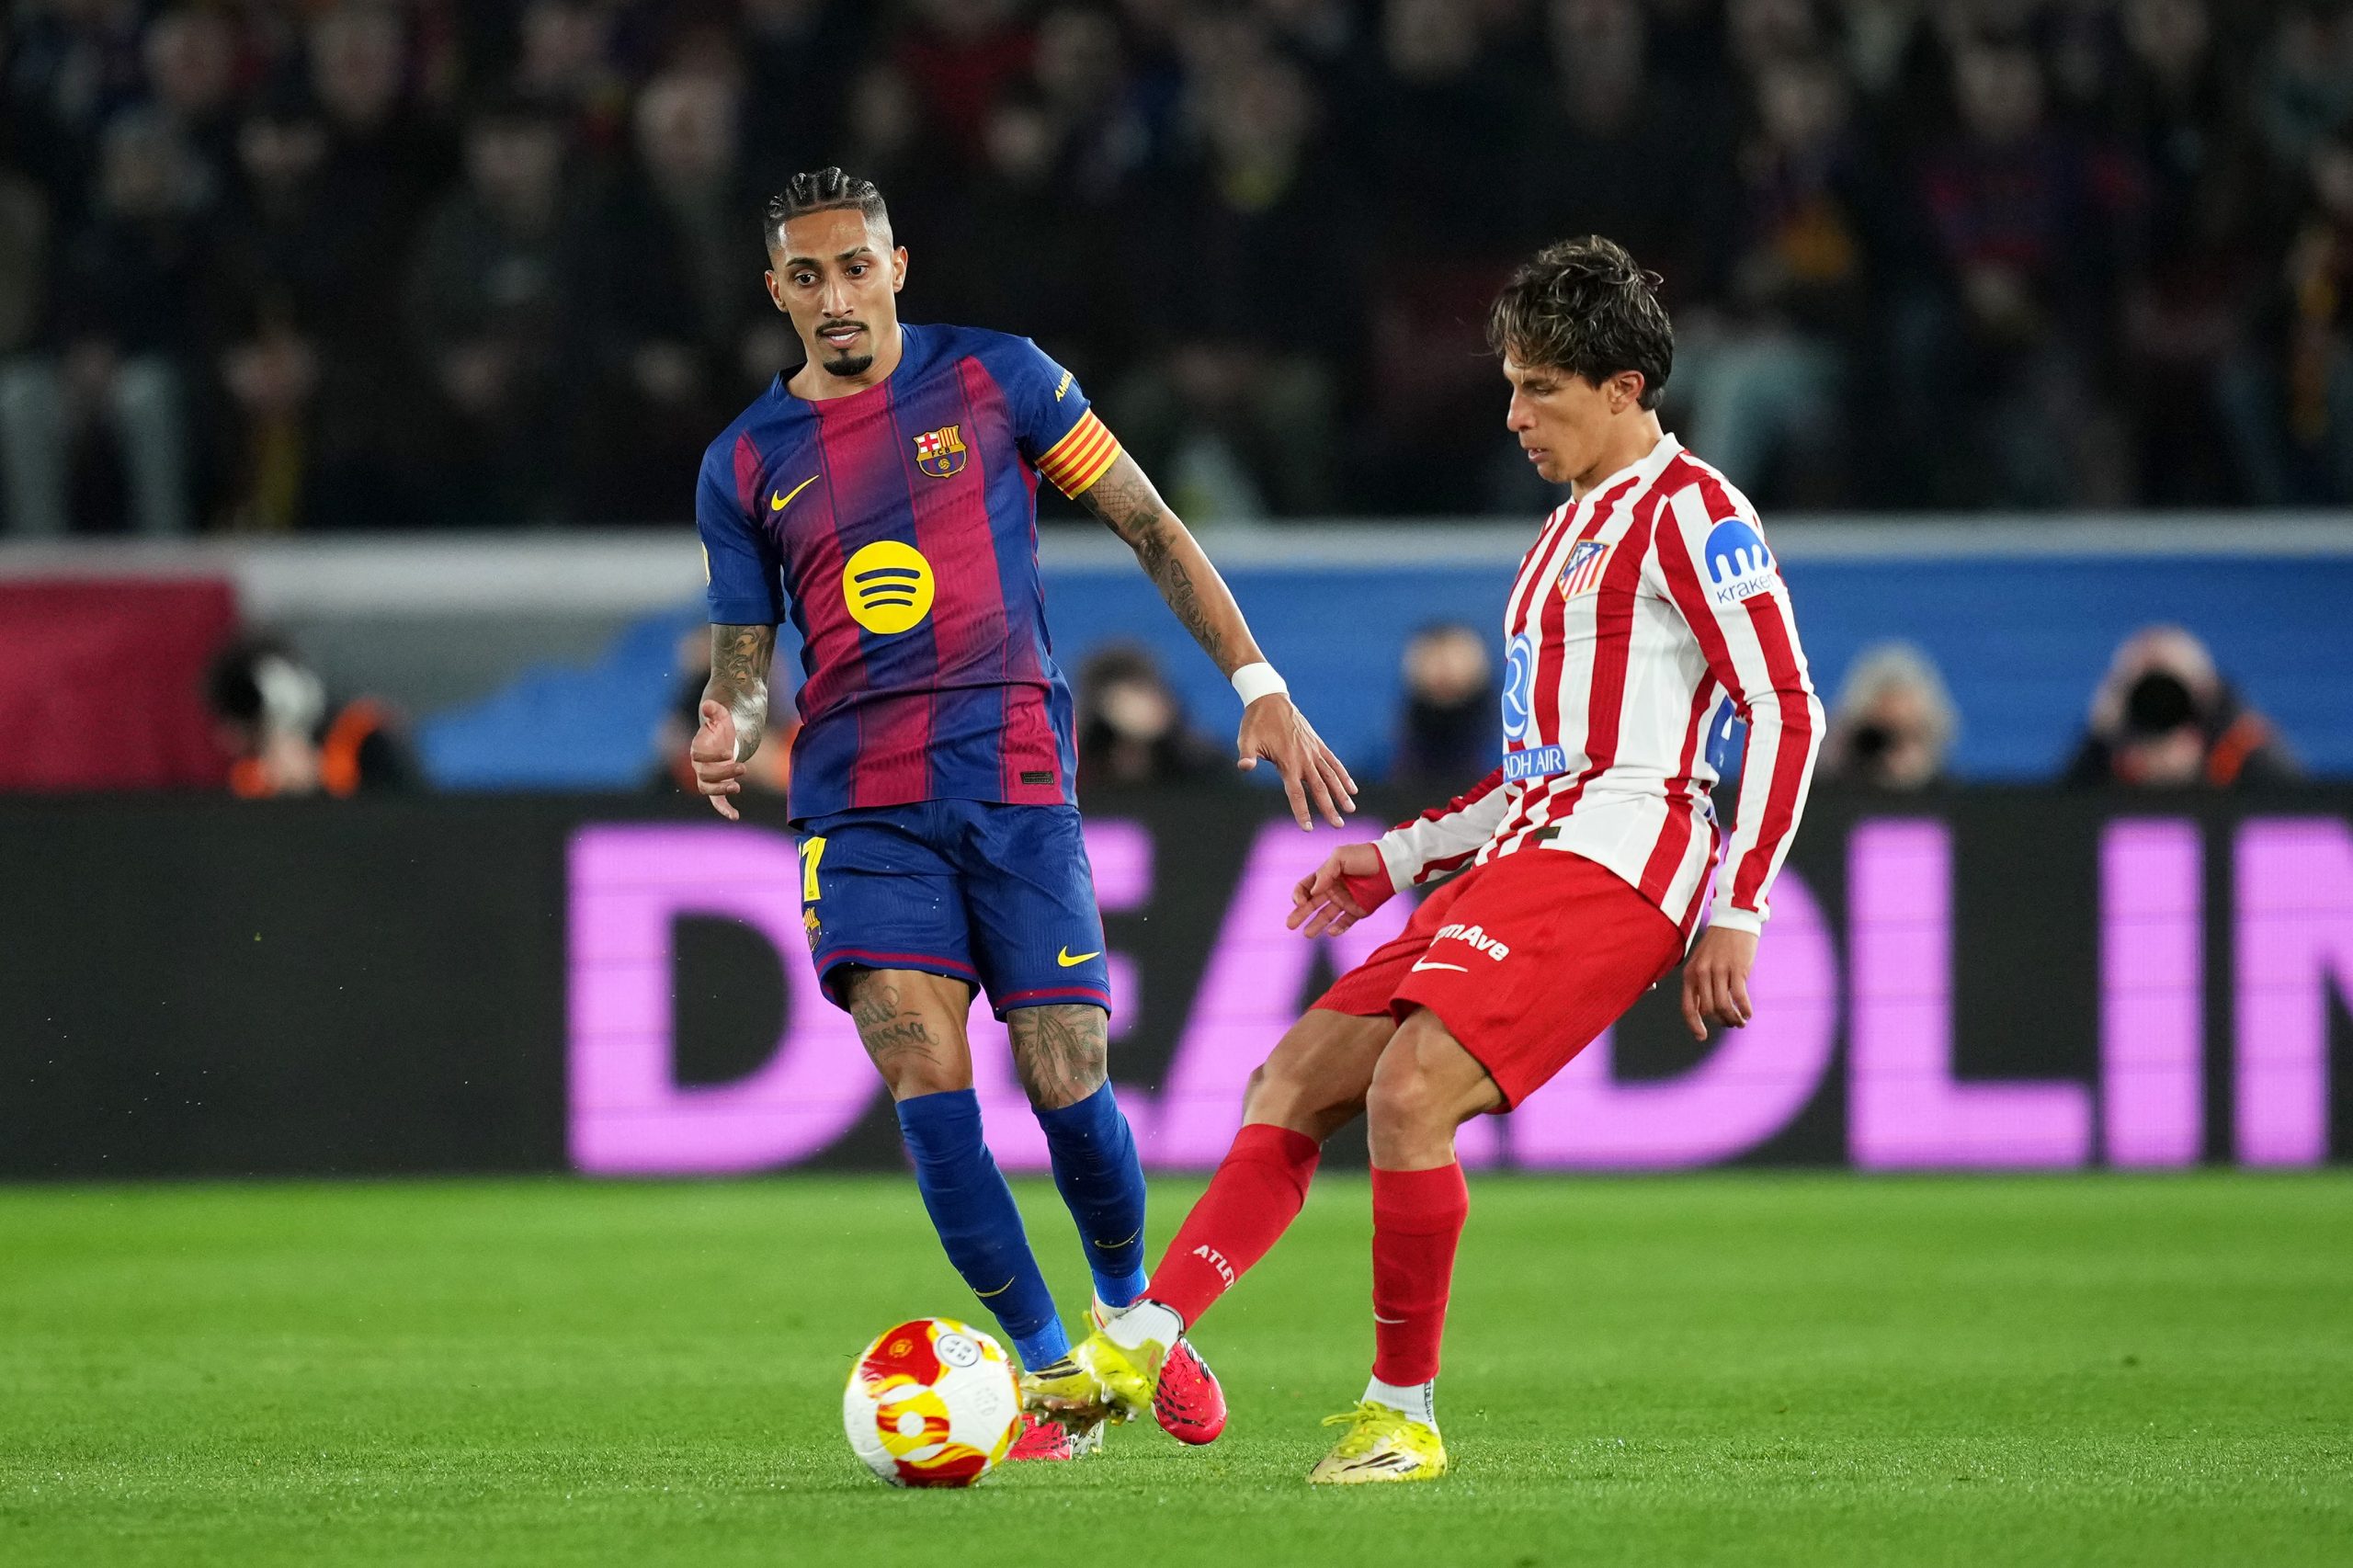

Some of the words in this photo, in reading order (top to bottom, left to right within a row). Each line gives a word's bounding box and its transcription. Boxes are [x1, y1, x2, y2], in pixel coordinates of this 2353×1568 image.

[931, 447, 951, 458] FCB
[1717, 574, 1780, 604] kraken
[1536, 747, 1563, 773] AIR
